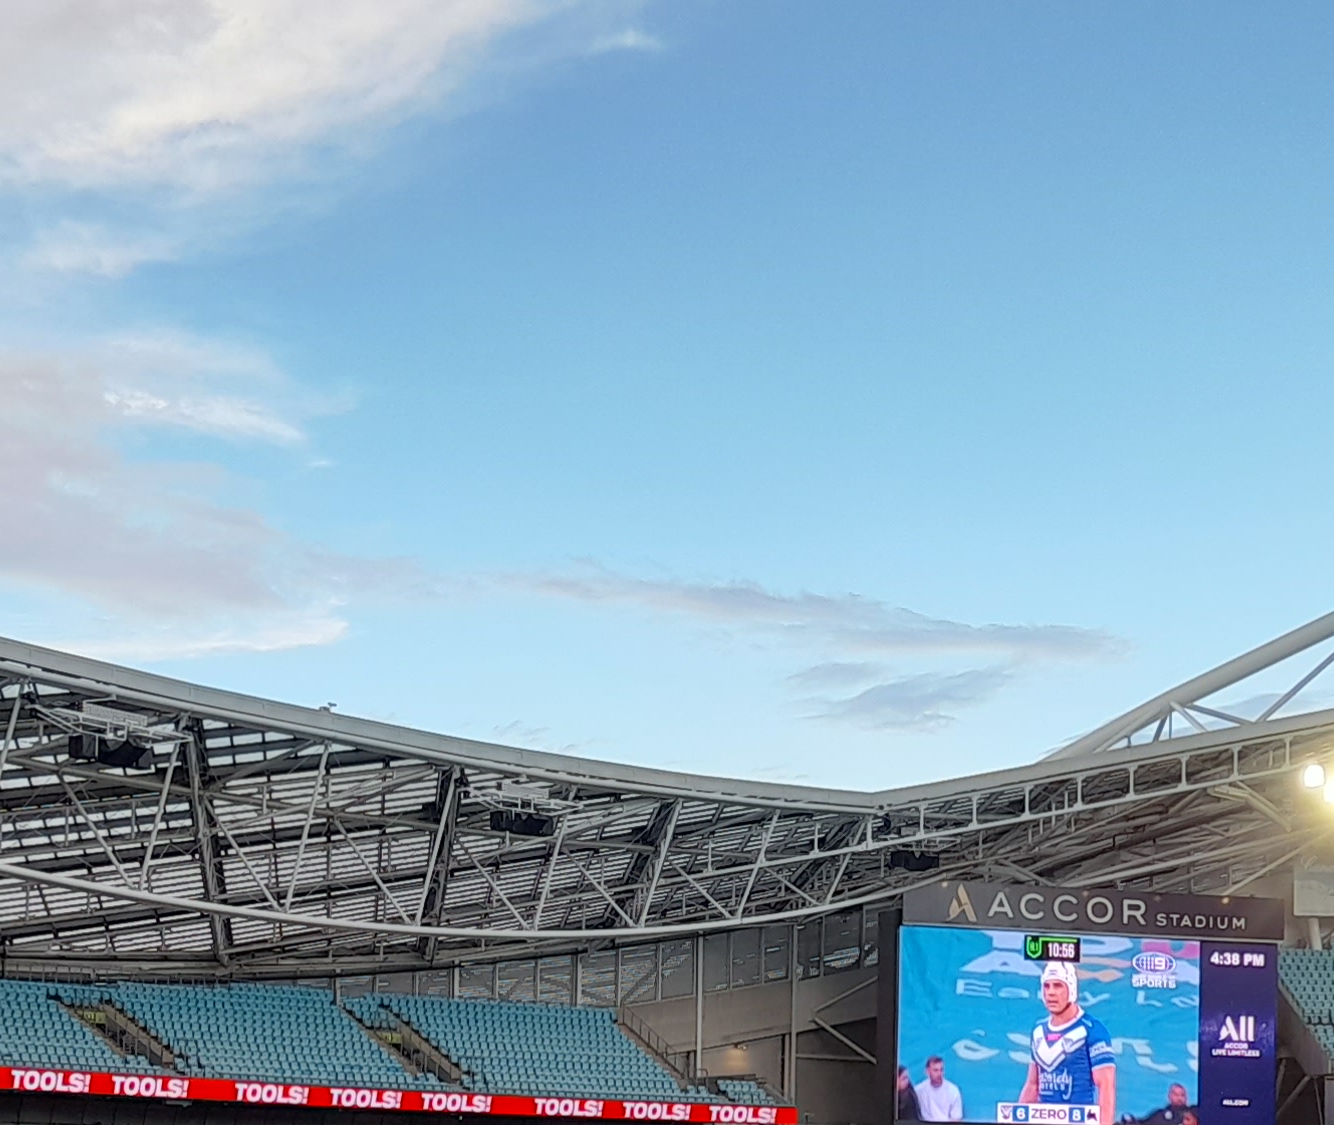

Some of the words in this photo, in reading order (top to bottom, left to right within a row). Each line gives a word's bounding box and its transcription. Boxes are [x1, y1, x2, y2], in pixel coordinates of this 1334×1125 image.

[987, 891, 1148, 927] ACCOR
[1155, 912, 1247, 931] STADIUM
[1210, 951, 1241, 966] 4:38
[1243, 952, 1265, 967] PM
[1132, 978, 1176, 989] SPORTS
[1218, 1015, 1255, 1042] All
[1211, 1049, 1227, 1057] LIVE
[1224, 1042, 1249, 1050] ACCOR
[11, 1069, 91, 1093] TOOLS!
[111, 1075, 189, 1098] TOOLS!
[234, 1082, 309, 1105] TOOLS!
[330, 1088, 403, 1109] TOOLS!
[421, 1092, 492, 1113] TOOLS!
[534, 1098, 604, 1117] TOOLS!
[622, 1101, 692, 1121] TOOLS!
[709, 1105, 777, 1124] TOOLS!
[1030, 1107, 1067, 1121] ZERO
[1072, 1109, 1081, 1122] 8
